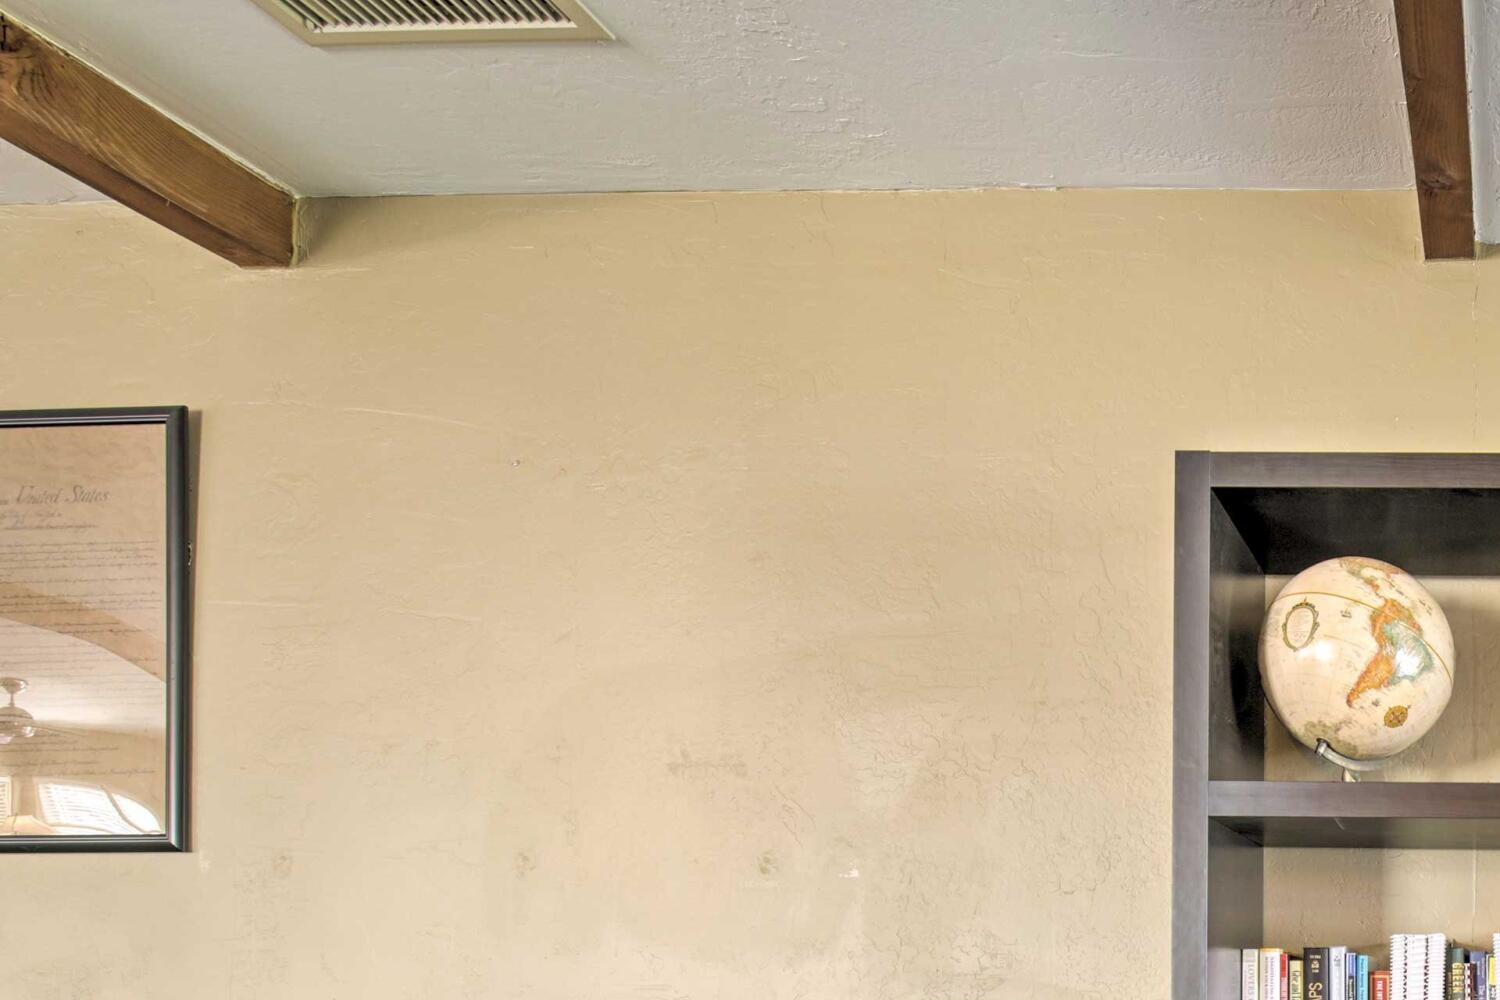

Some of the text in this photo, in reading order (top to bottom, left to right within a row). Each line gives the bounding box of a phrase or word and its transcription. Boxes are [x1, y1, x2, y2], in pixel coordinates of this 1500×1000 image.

[17, 485, 110, 504] United States
[1452, 963, 1464, 993] GREEN
